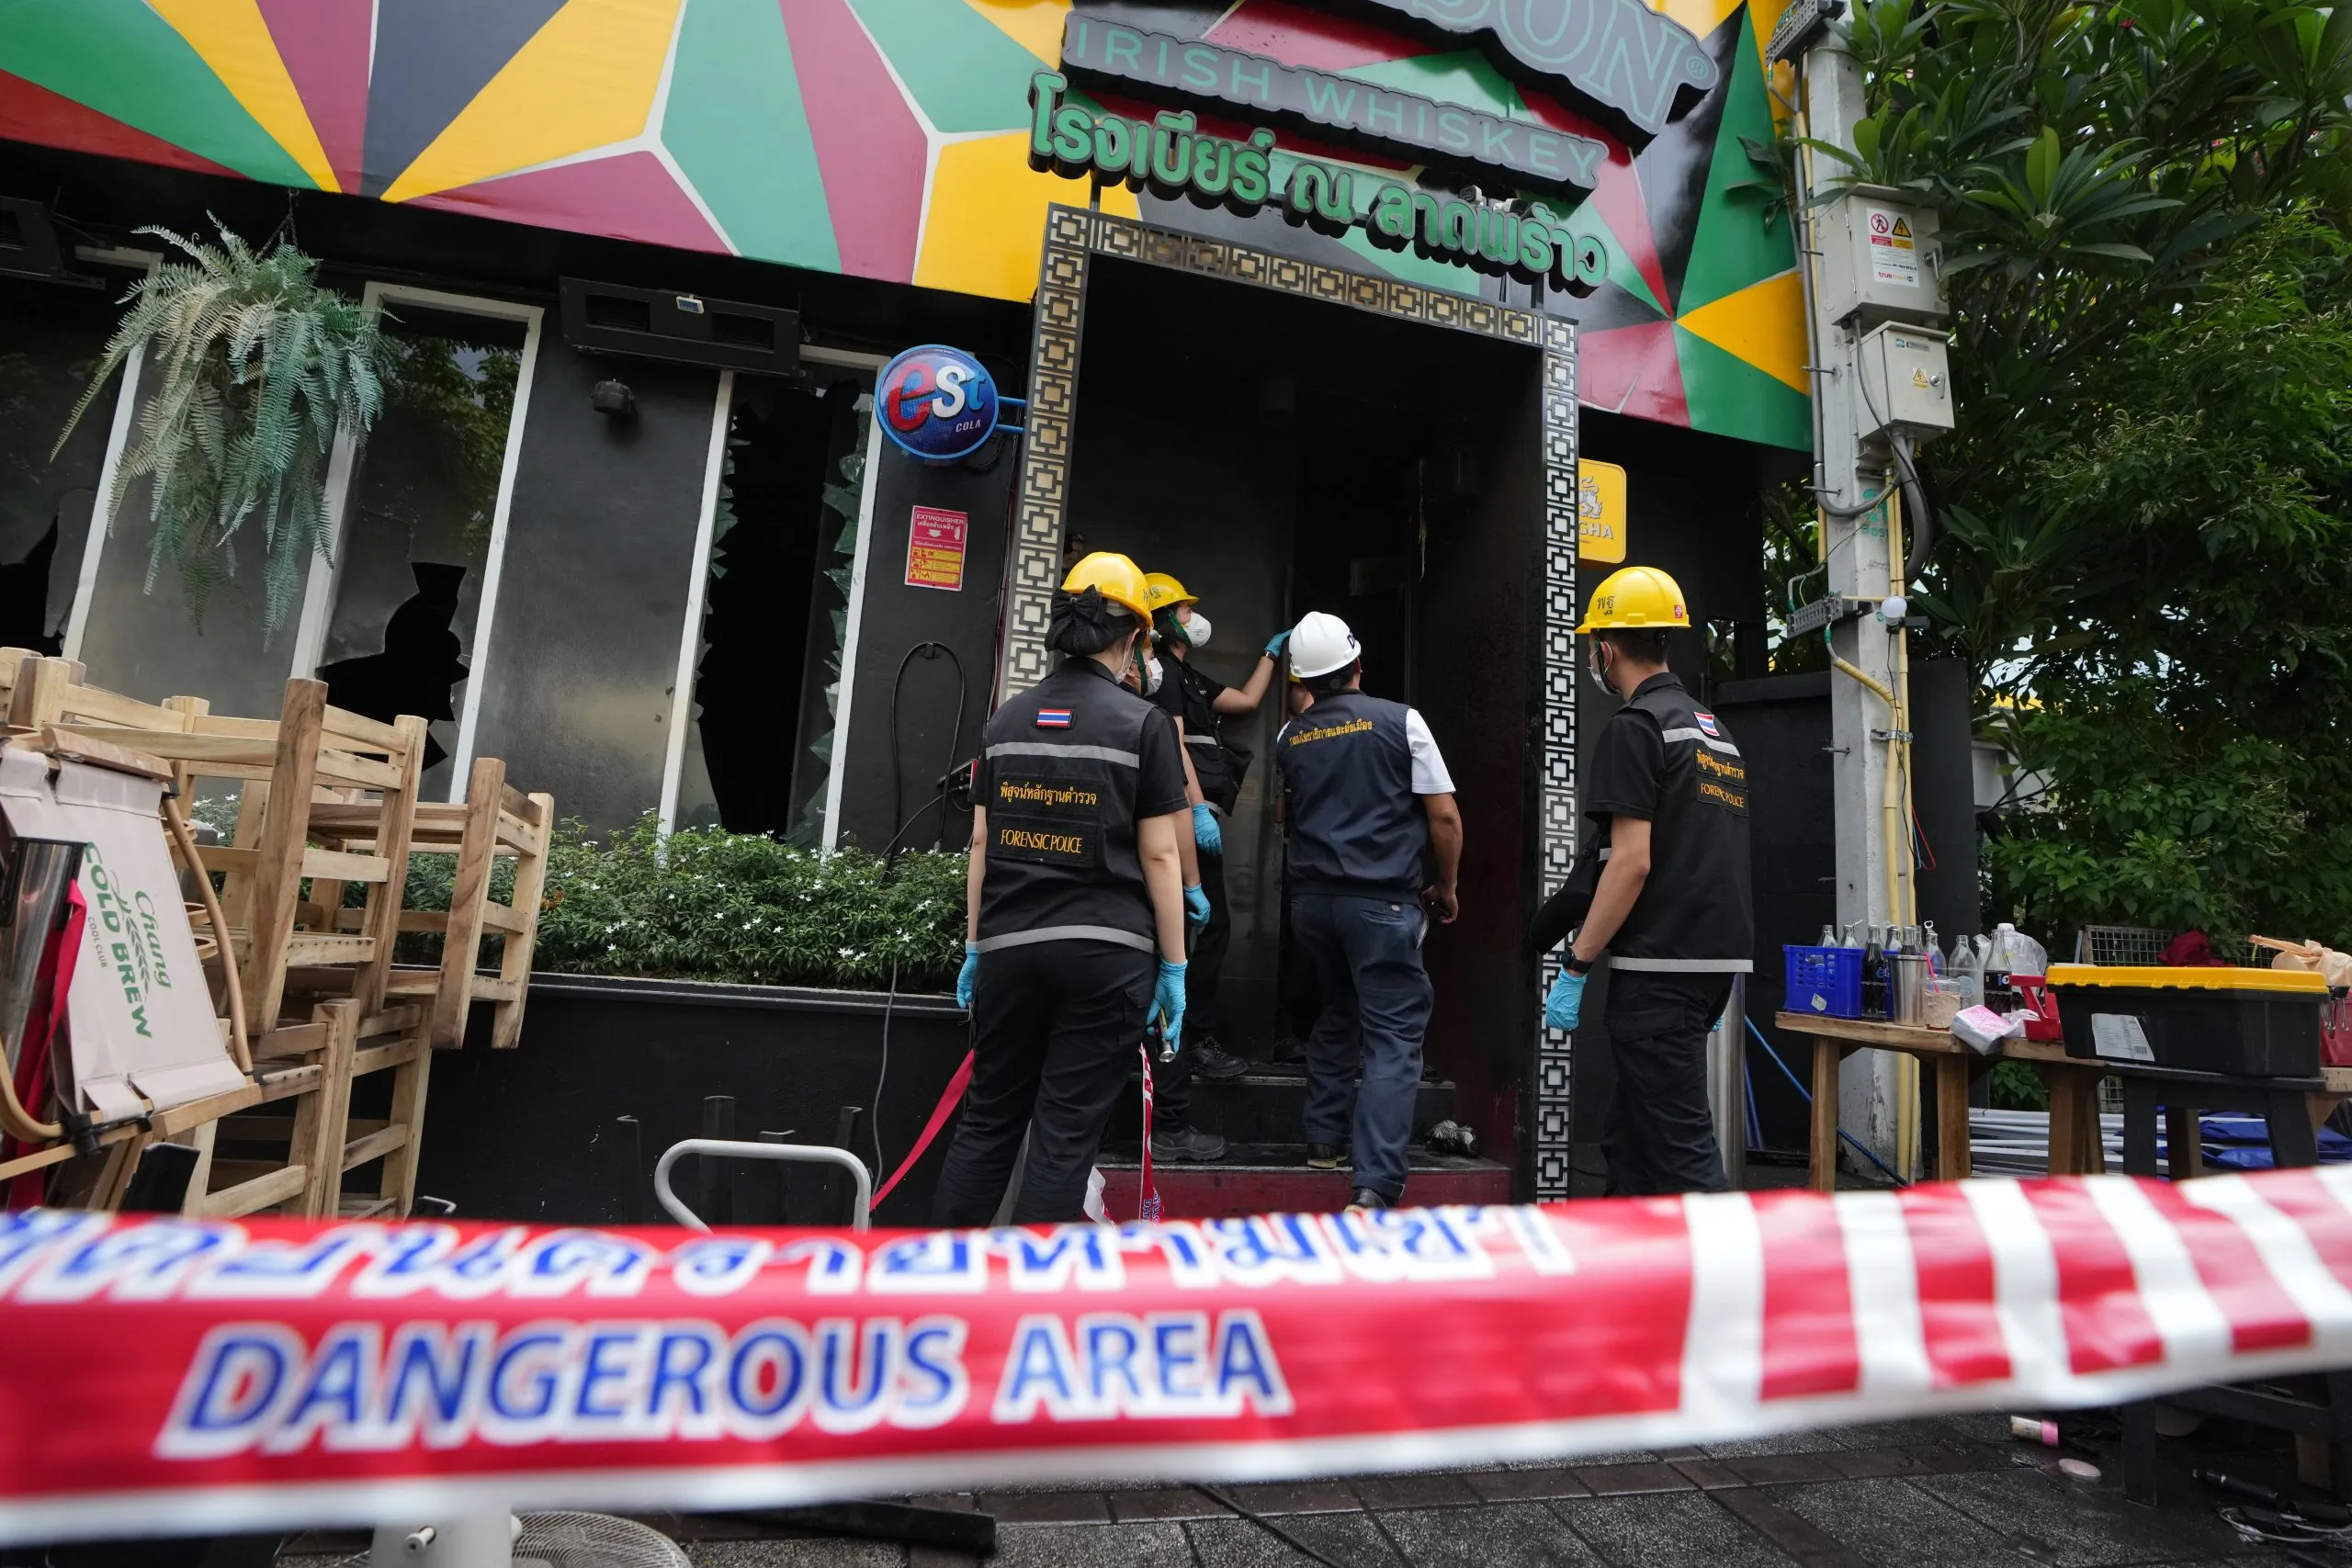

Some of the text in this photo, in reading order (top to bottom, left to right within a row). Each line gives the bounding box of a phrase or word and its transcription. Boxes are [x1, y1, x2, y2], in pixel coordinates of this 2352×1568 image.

[1076, 22, 1600, 181] IRISH WHISKEY
[1412, 0, 1691, 125] ON
[1029, 70, 1610, 288] โรงเบียร์ ณ ลาดพร้าว
[956, 420, 981, 433] COLA
[916, 513, 964, 525] EXTINGUISHER
[1001, 782, 1097, 806] พิสูจน์หลักฐานตำรวจ
[1001, 829, 1082, 853] FORENSIC POLICE
[85, 841, 153, 1038] COLD BREW
[88, 917, 107, 968] COOL CLUB
[135, 890, 172, 989] Chang
[156, 1309, 1294, 1460] DANGEROUS AREA
